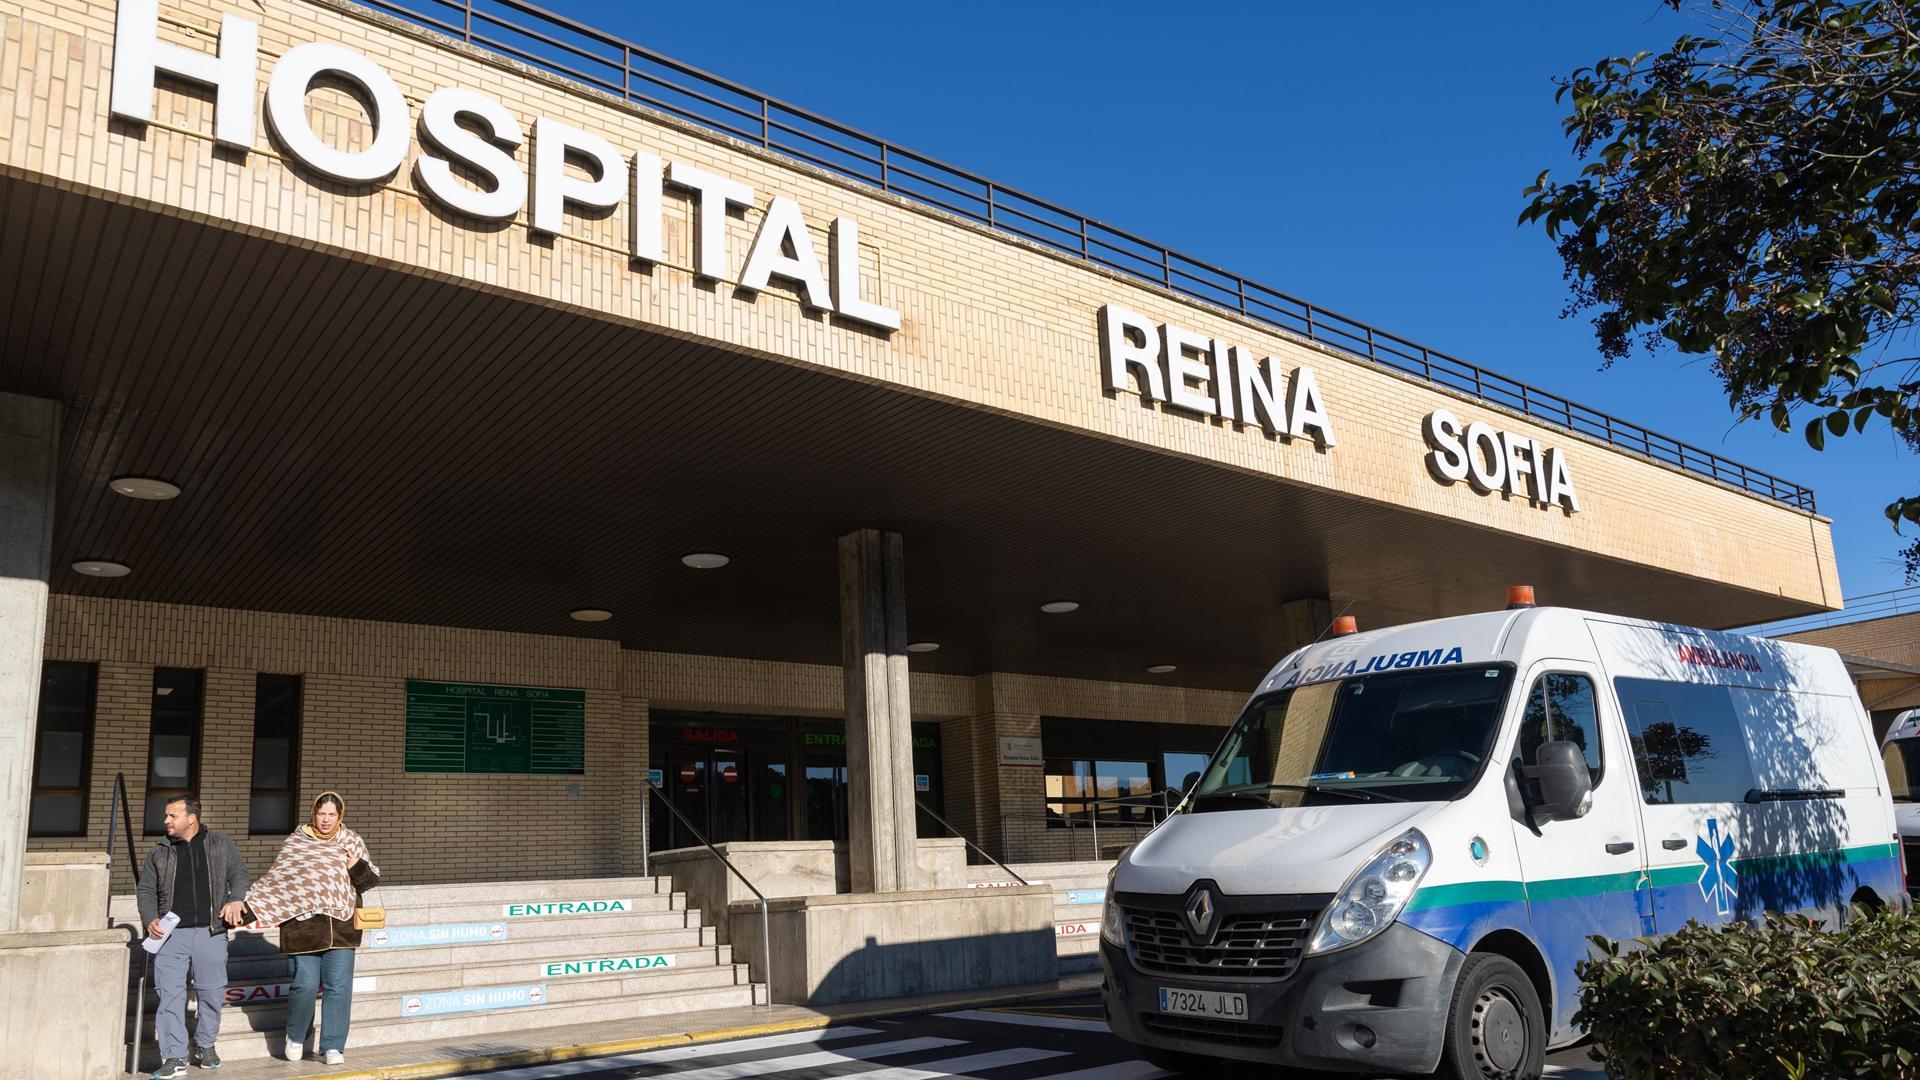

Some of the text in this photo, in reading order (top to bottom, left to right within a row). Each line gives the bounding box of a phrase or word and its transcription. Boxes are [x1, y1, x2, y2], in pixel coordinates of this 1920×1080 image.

[111, 0, 1581, 513] HOSPITAL REINA SOFIA
[1677, 644, 1763, 673] AMBULANCIA
[445, 686, 550, 699] HOSPITAL REINA SOFIA
[682, 728, 741, 742] SALIDA
[509, 900, 625, 916] ENTRADA
[392, 926, 487, 943] ZONA SIN HUMO
[547, 956, 668, 976] ENTRADA
[425, 990, 526, 1009] ZONA SIN HUMO
[1171, 991, 1244, 1015] 7324 JLD
